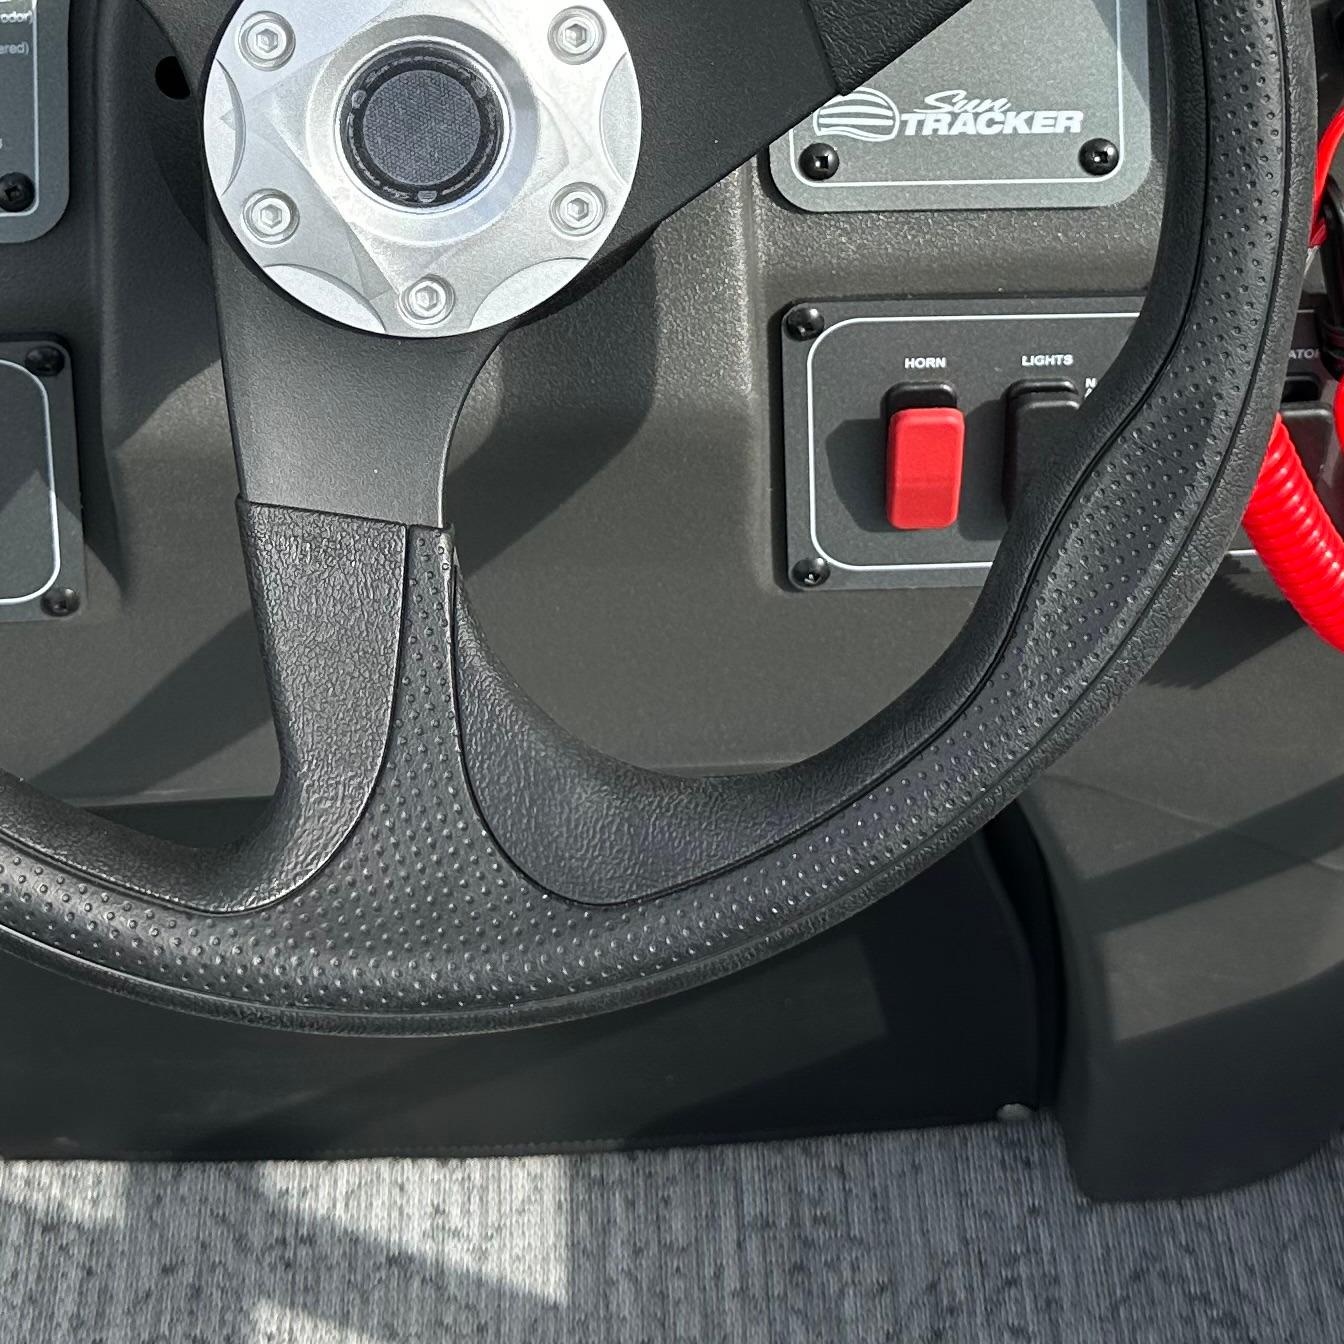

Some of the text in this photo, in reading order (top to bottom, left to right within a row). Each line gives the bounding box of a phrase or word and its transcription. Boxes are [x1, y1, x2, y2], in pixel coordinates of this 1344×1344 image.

[0, 10, 33, 24] odor)
[913, 90, 1012, 113] Sun
[901, 110, 1084, 135] TRACKER
[905, 357, 946, 368] HORN
[1021, 354, 1074, 366] LIGHTS
